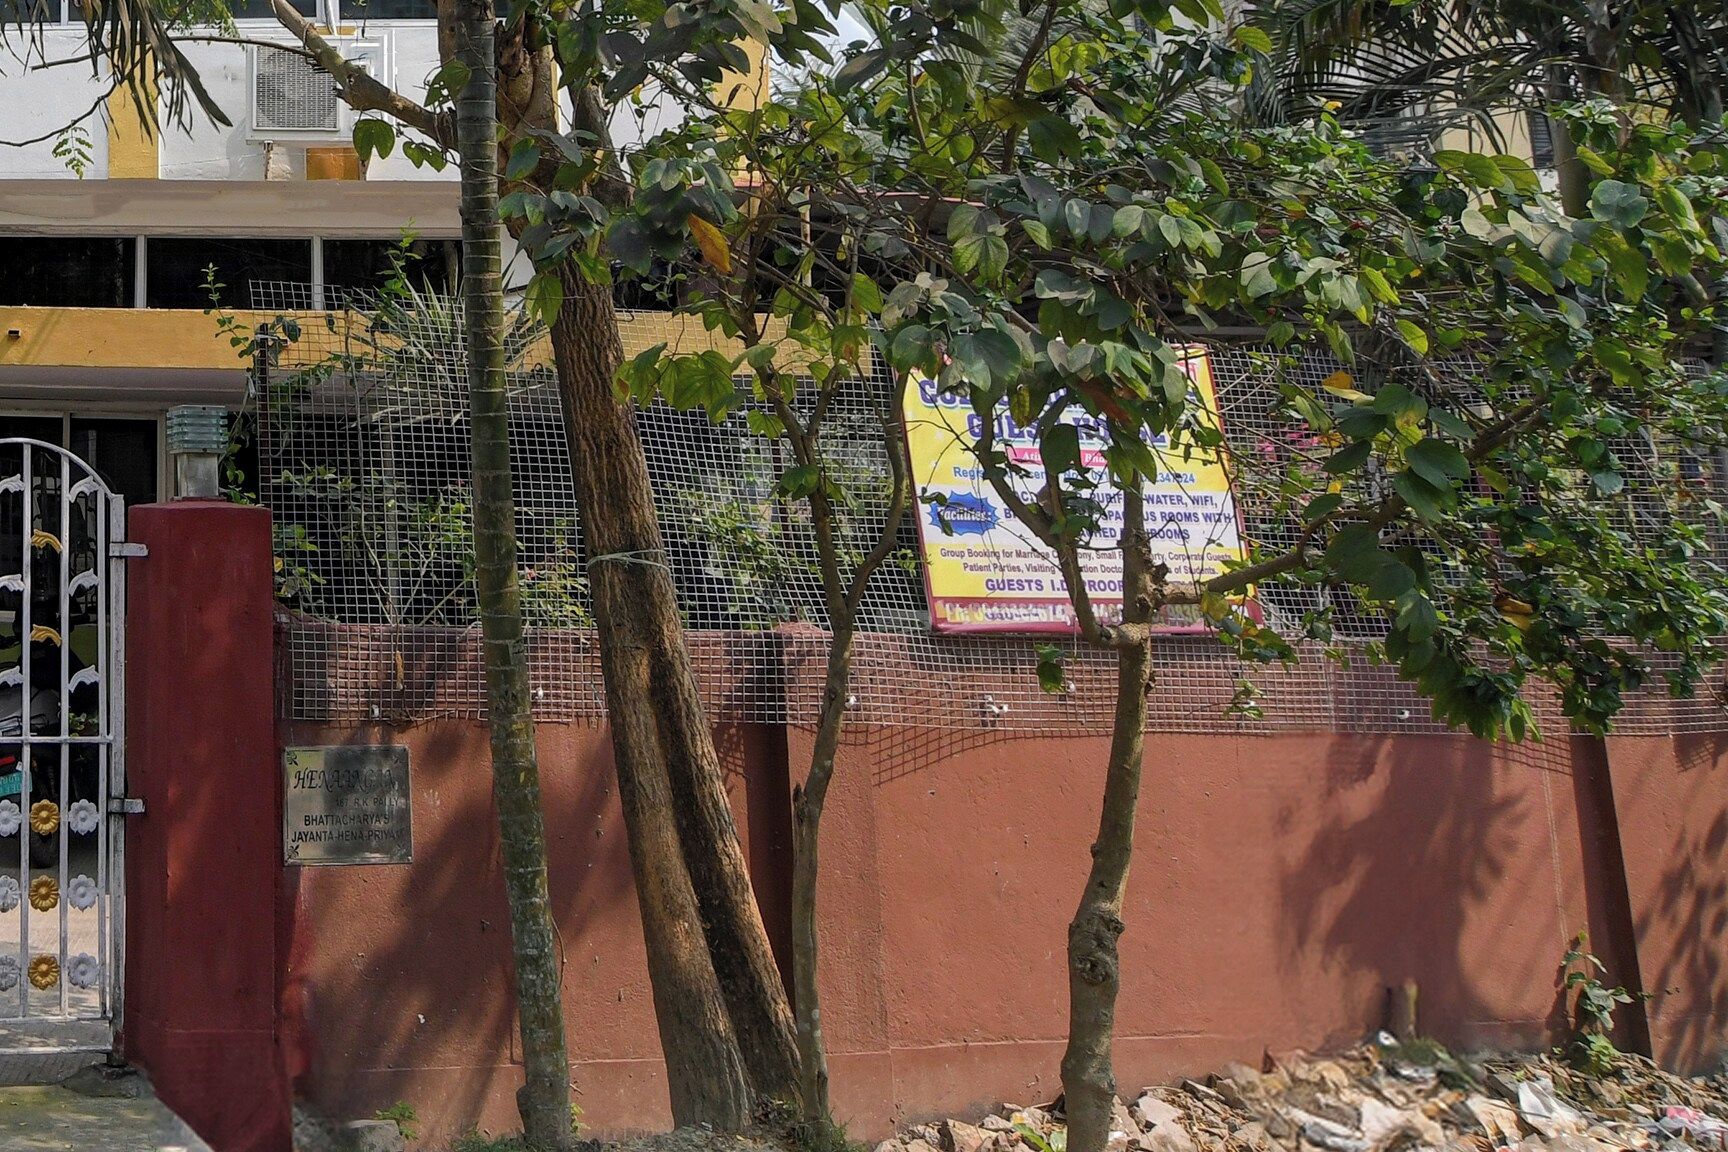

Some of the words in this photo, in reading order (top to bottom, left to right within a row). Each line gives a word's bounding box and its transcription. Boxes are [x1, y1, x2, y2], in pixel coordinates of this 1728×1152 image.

[1144, 494, 1188, 507] WATER,
[1159, 511, 1200, 523] ROOMS
[1202, 512, 1232, 524] WITH
[940, 548, 966, 559] Group
[967, 548, 1000, 560] Booking
[1002, 549, 1013, 558] for
[1096, 550, 1117, 559] Small
[963, 562, 991, 572] Patient
[993, 562, 1024, 574] Parties,
[1025, 563, 1056, 575] Visiting
[1100, 564, 1124, 574] Docto
[985, 578, 1044, 592] GUESTS
